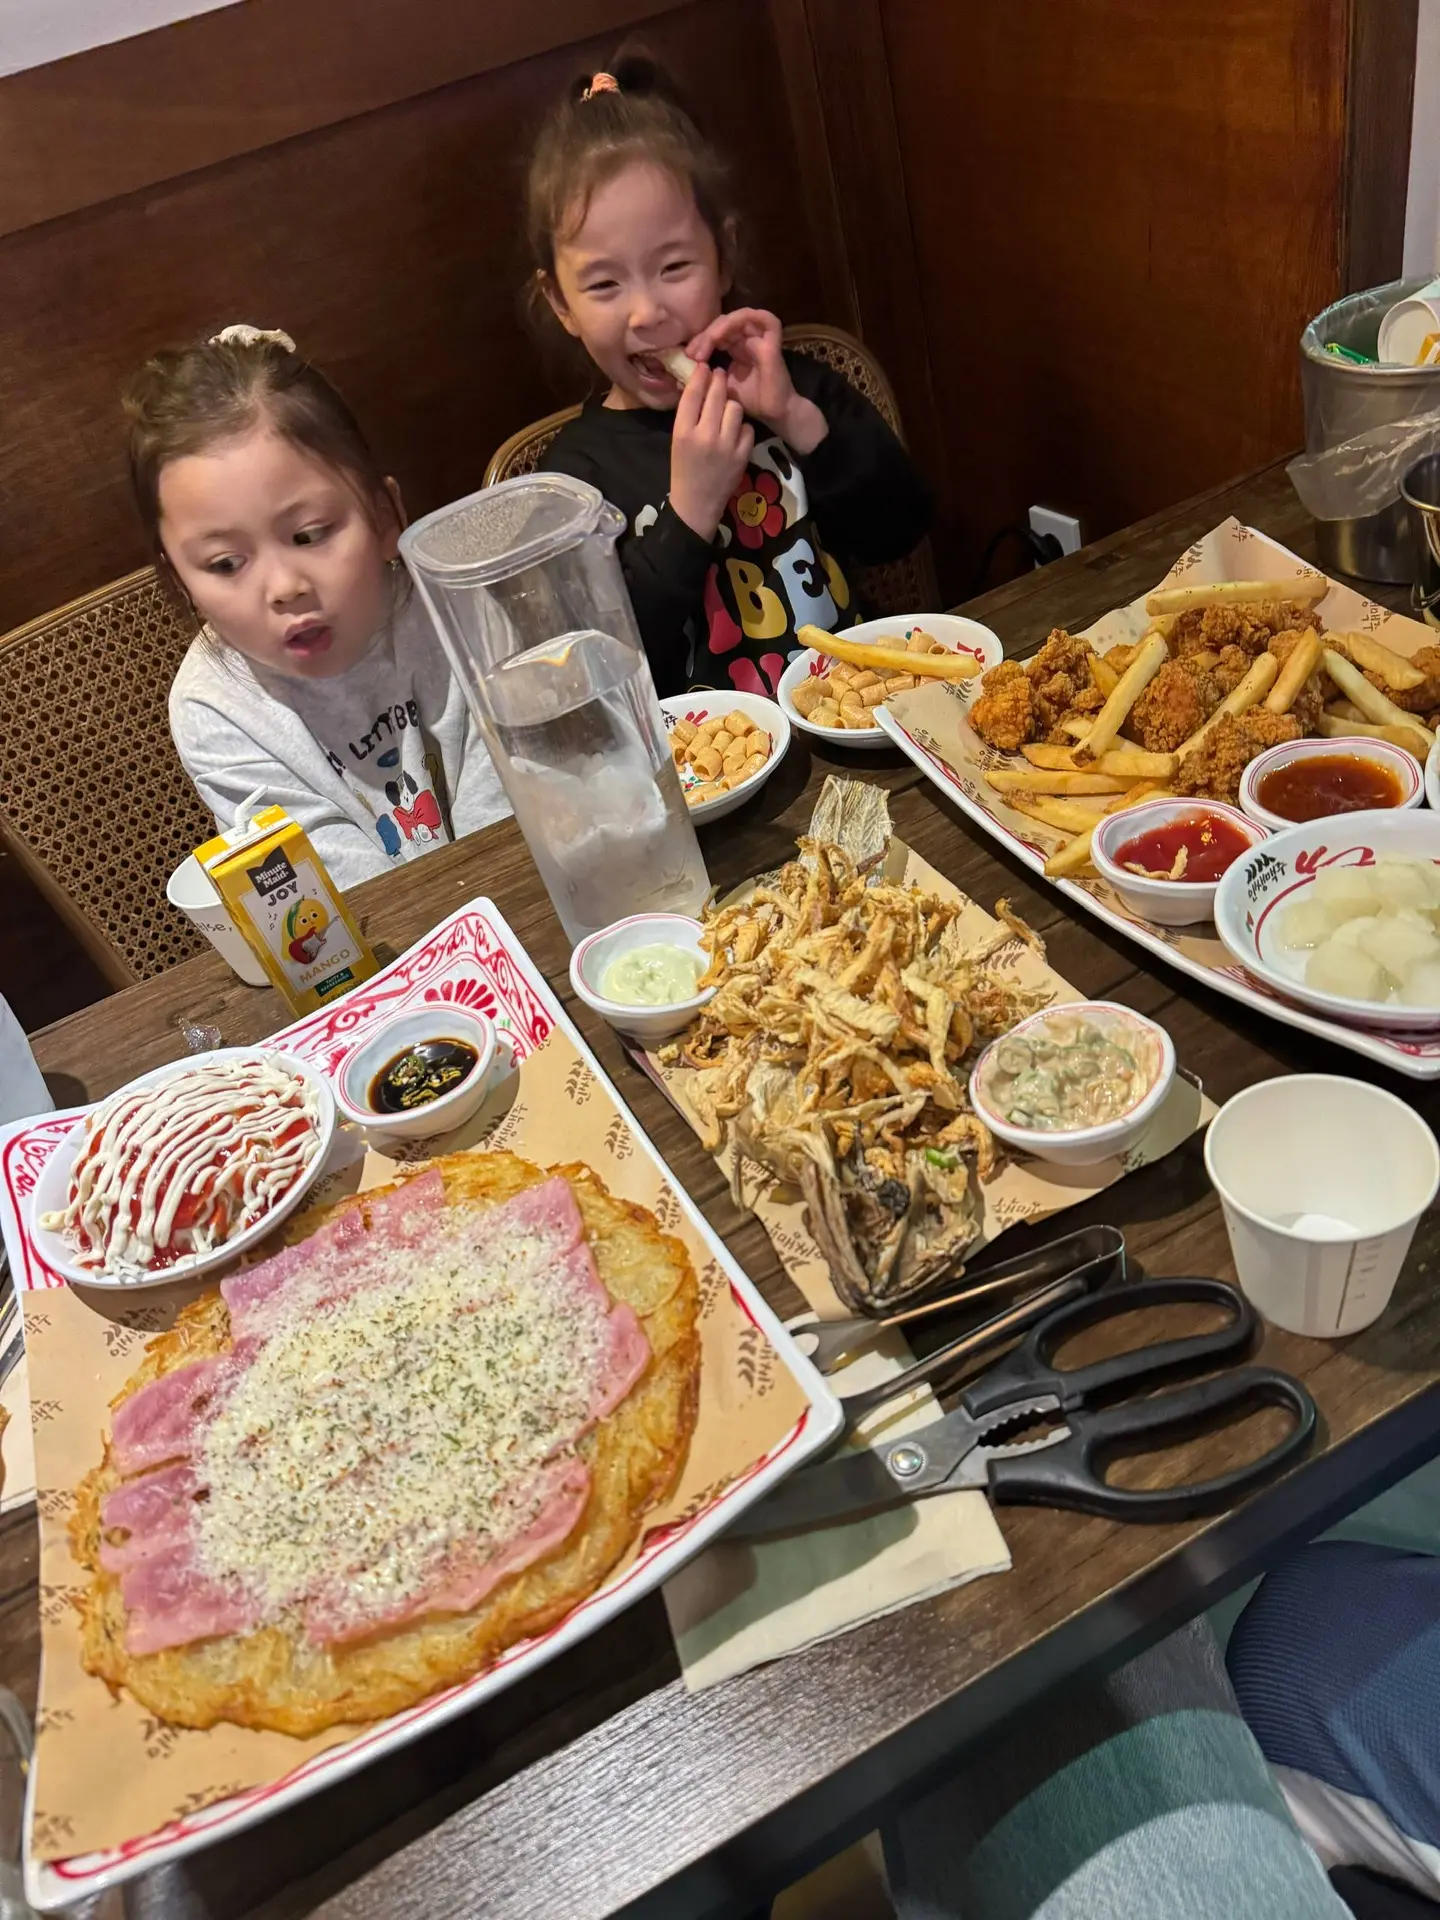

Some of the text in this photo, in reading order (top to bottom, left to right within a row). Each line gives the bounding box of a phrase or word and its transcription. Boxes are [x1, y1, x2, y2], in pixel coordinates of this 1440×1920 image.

[255, 860, 287, 884] Minute
[263, 870, 287, 889] Maid
[1247, 861, 1288, 902] 인생맥주
[267, 881, 299, 907] JOY
[299, 949, 351, 984] MANGO
